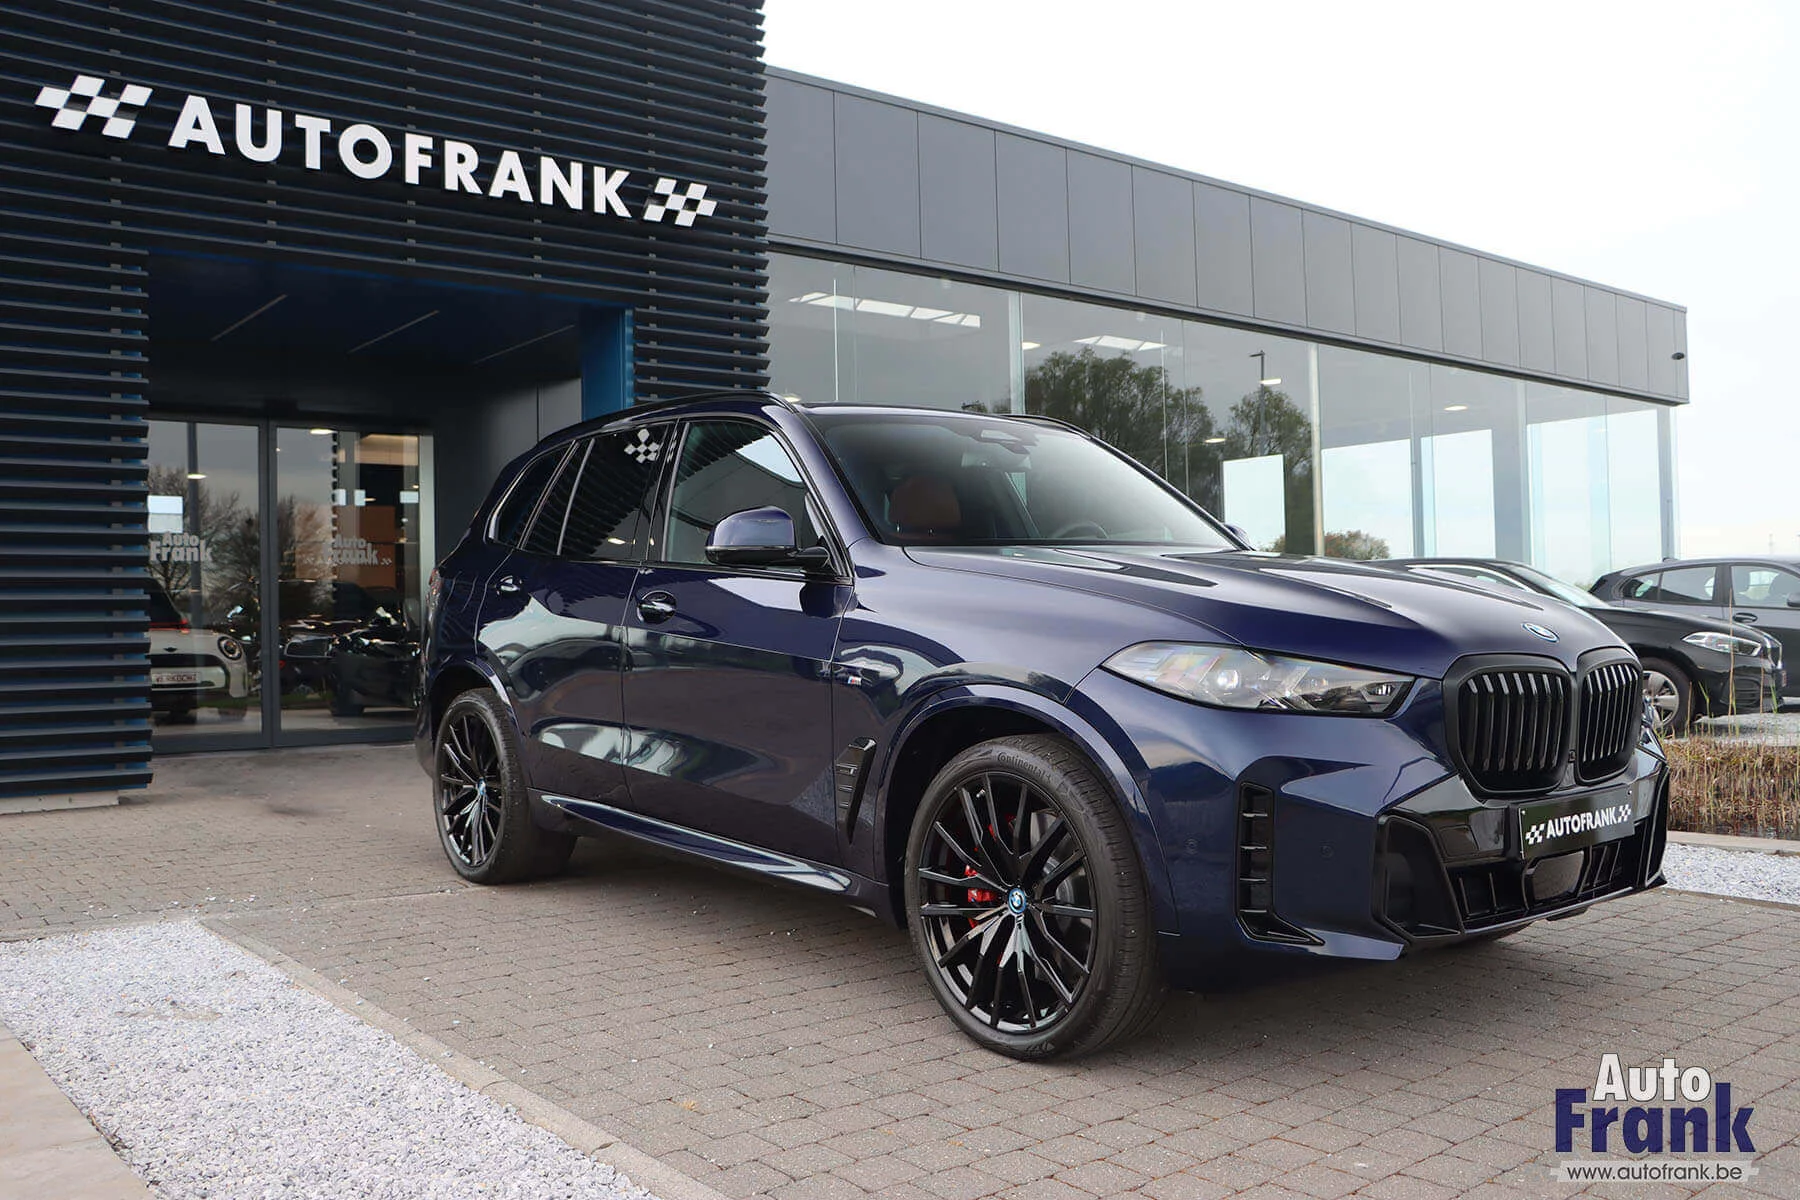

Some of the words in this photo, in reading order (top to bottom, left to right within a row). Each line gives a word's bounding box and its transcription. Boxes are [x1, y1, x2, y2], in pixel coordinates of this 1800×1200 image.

[168, 94, 632, 218] AUTOFRANK
[150, 540, 213, 562] Frank
[162, 531, 199, 547] Auto
[997, 751, 1045, 777] Continental
[1546, 807, 1617, 839] AUTOFRANK
